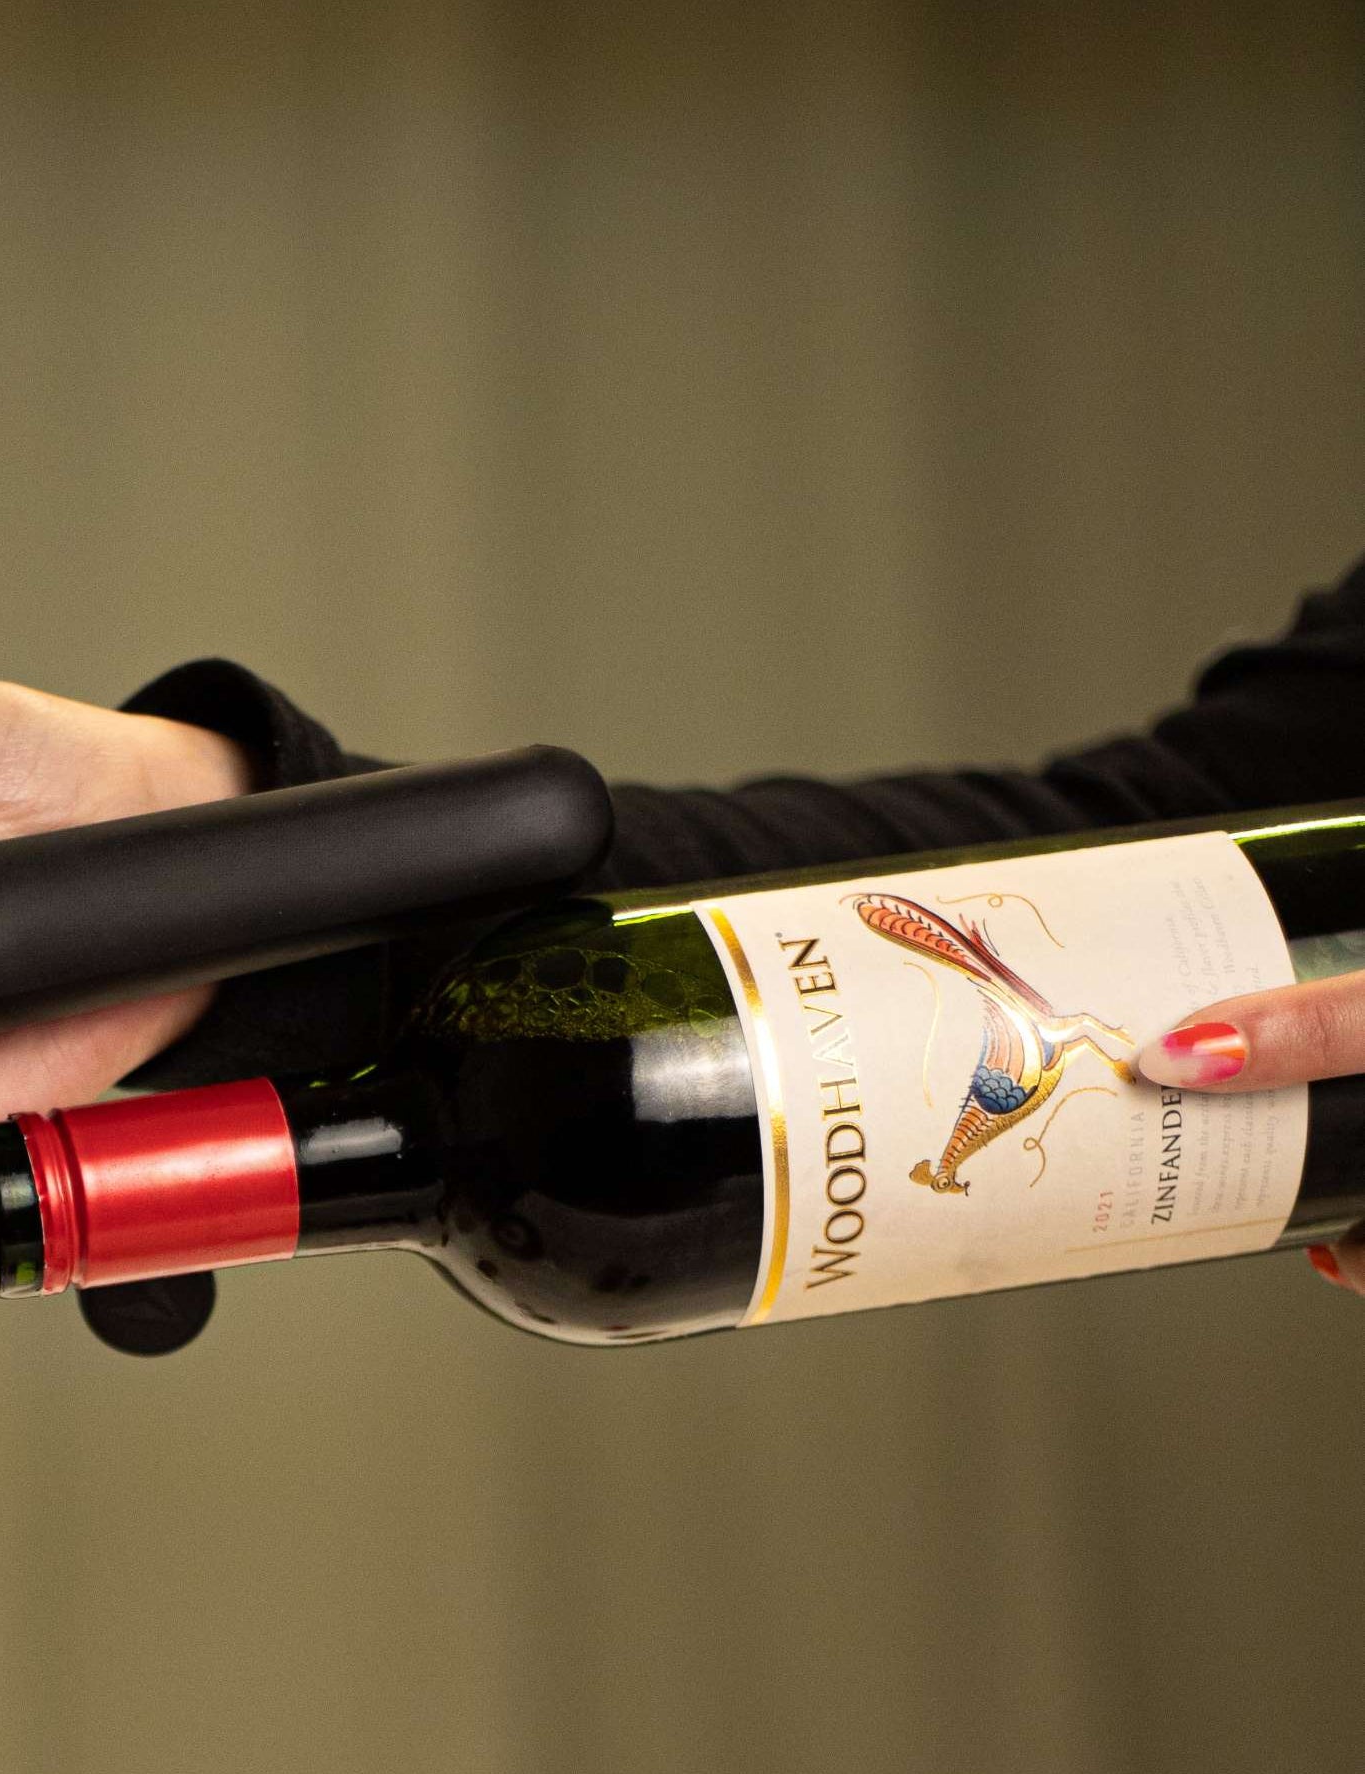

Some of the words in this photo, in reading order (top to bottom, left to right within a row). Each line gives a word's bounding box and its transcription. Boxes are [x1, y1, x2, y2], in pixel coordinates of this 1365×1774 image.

[778, 937, 868, 1290] WOODHAVEN
[1119, 1111, 1145, 1229] CALIFORNIA
[1092, 1191, 1114, 1233] 2021
